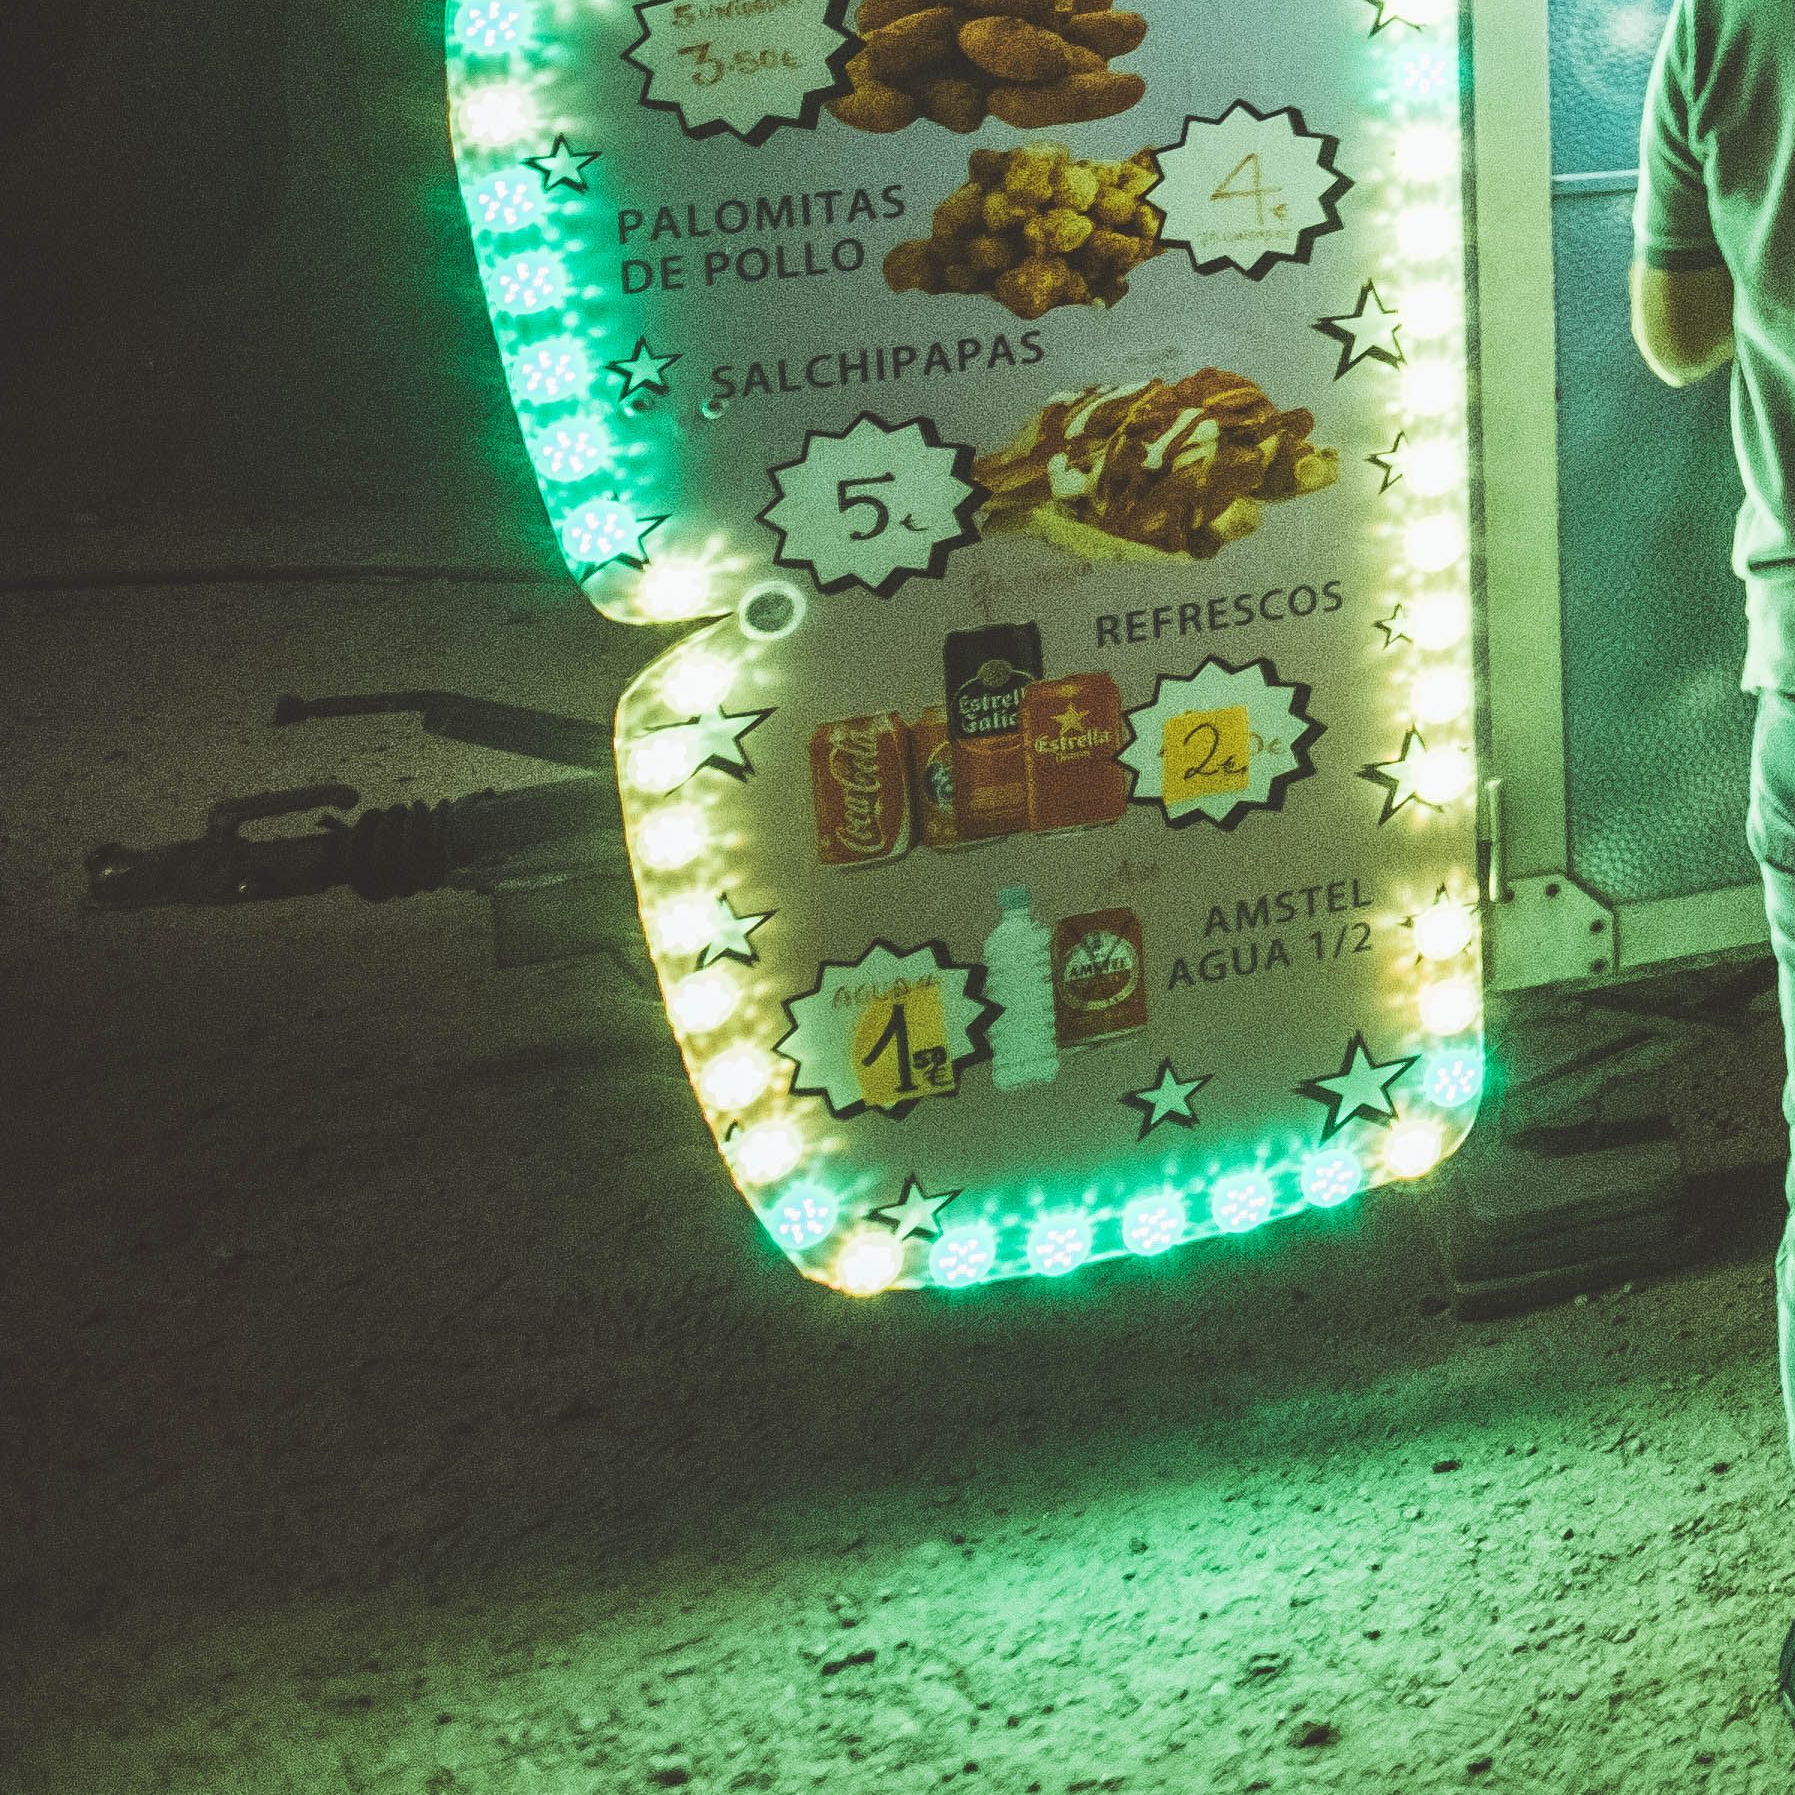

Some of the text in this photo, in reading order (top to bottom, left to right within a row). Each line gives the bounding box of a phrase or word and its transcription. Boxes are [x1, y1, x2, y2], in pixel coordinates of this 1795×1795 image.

[616, 183, 907, 246] PALOMITAS
[620, 236, 867, 297] DE POLLO
[710, 328, 1047, 402] SALCHIPAPAS
[1094, 578, 1344, 652] REFRESCOS
[1203, 877, 1375, 939] AMSTEL
[1166, 922, 1375, 991] AGUA 1/2
